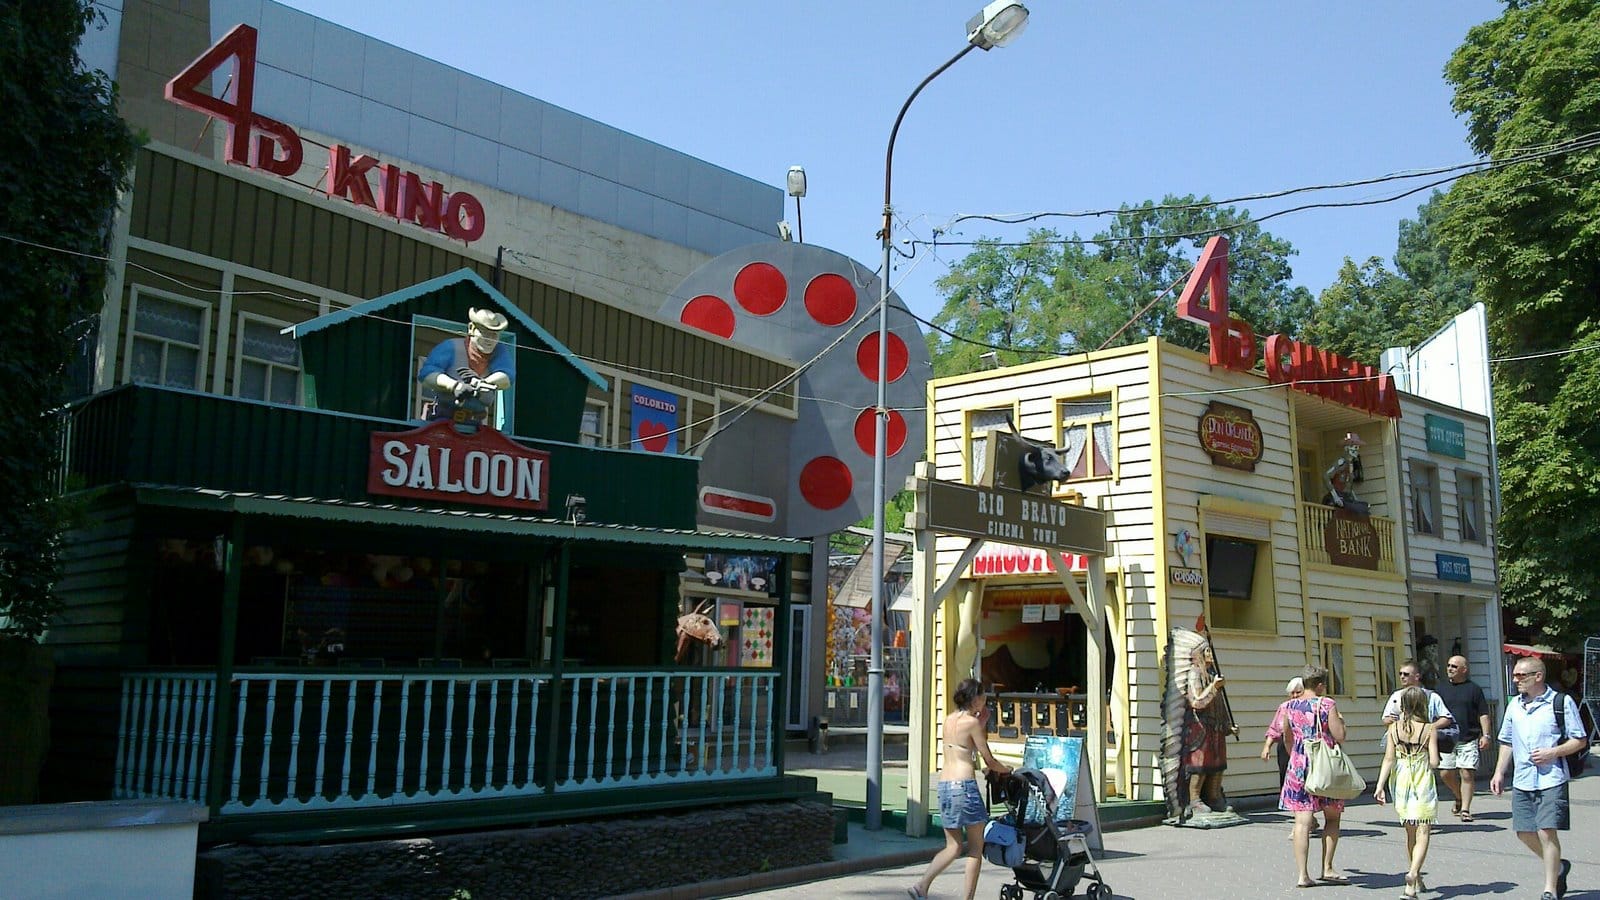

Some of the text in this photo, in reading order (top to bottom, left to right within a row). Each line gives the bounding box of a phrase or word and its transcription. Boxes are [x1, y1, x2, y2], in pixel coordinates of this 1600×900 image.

[164, 24, 486, 242] 4D KINO
[633, 394, 676, 413] COLORITO
[381, 440, 544, 502] SALOON
[978, 491, 1067, 527] RIO BRAVO
[988, 520, 1058, 545] CINEMA TOWN
[1340, 535, 1373, 557] BANK
